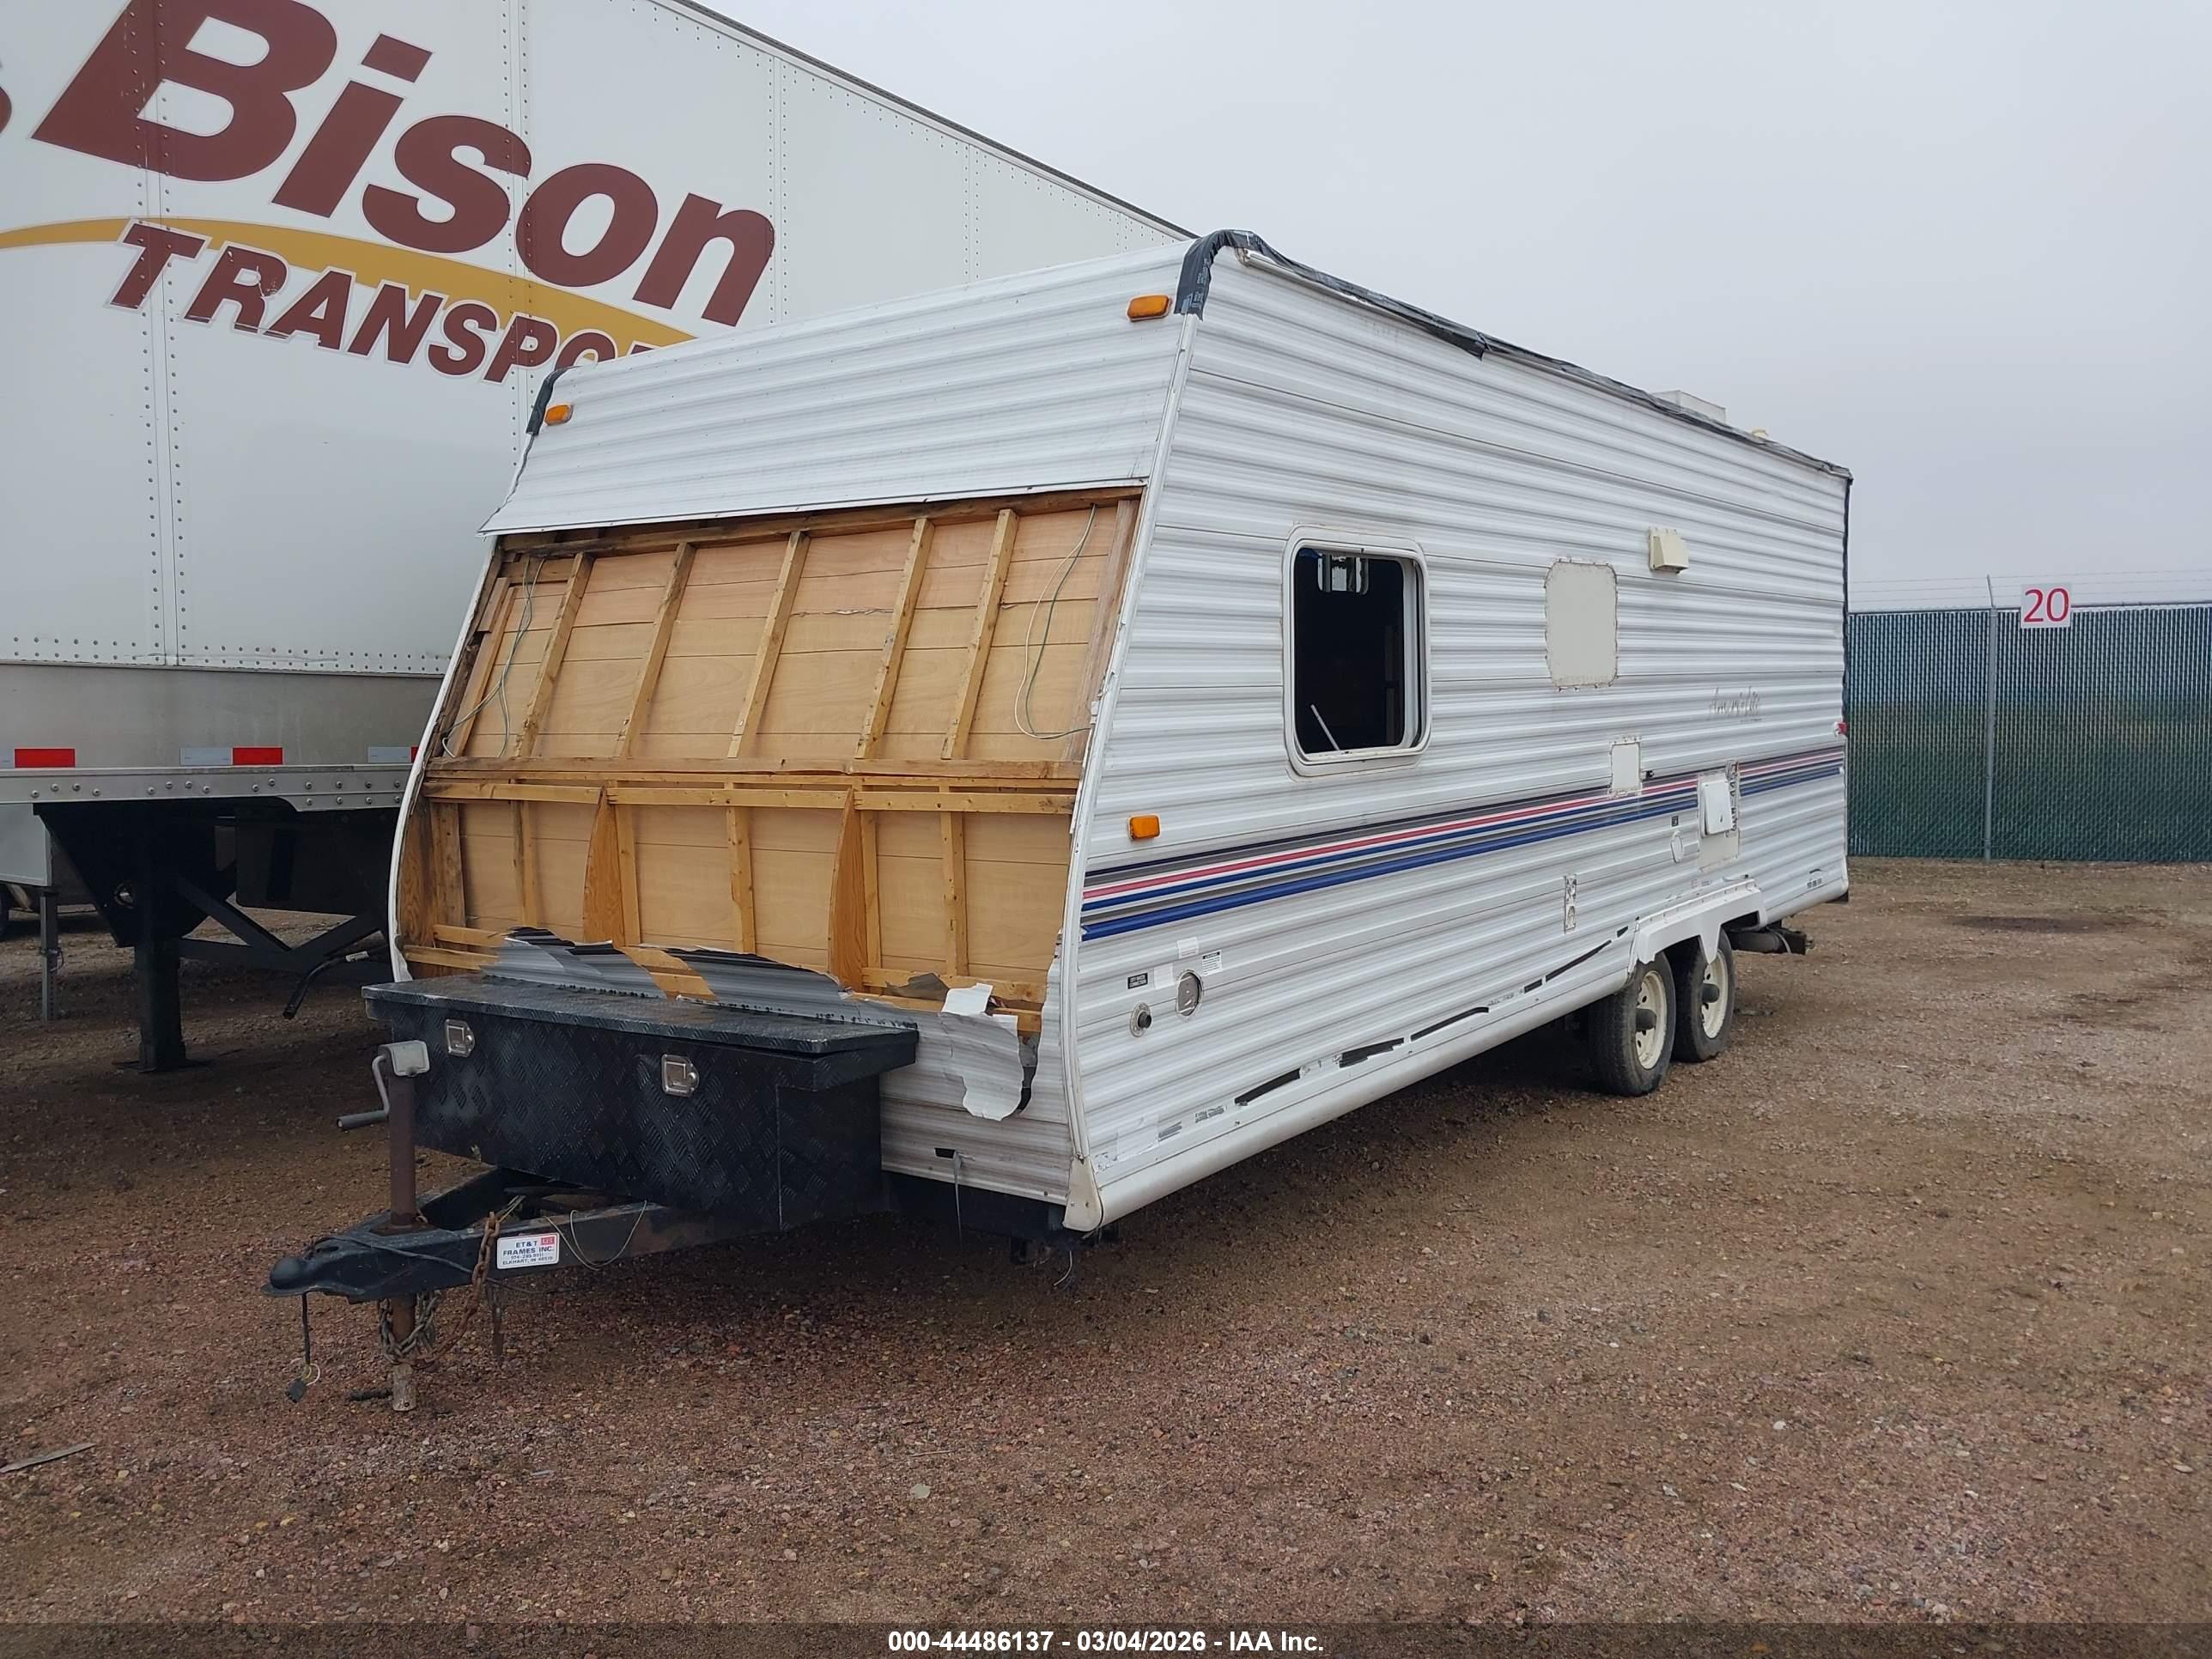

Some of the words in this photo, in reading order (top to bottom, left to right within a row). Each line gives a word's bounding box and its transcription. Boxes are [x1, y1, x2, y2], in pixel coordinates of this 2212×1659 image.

[31, 0, 775, 327] Bison
[2023, 587, 2069, 623] 20
[502, 1248, 536, 1256] FRAMES
